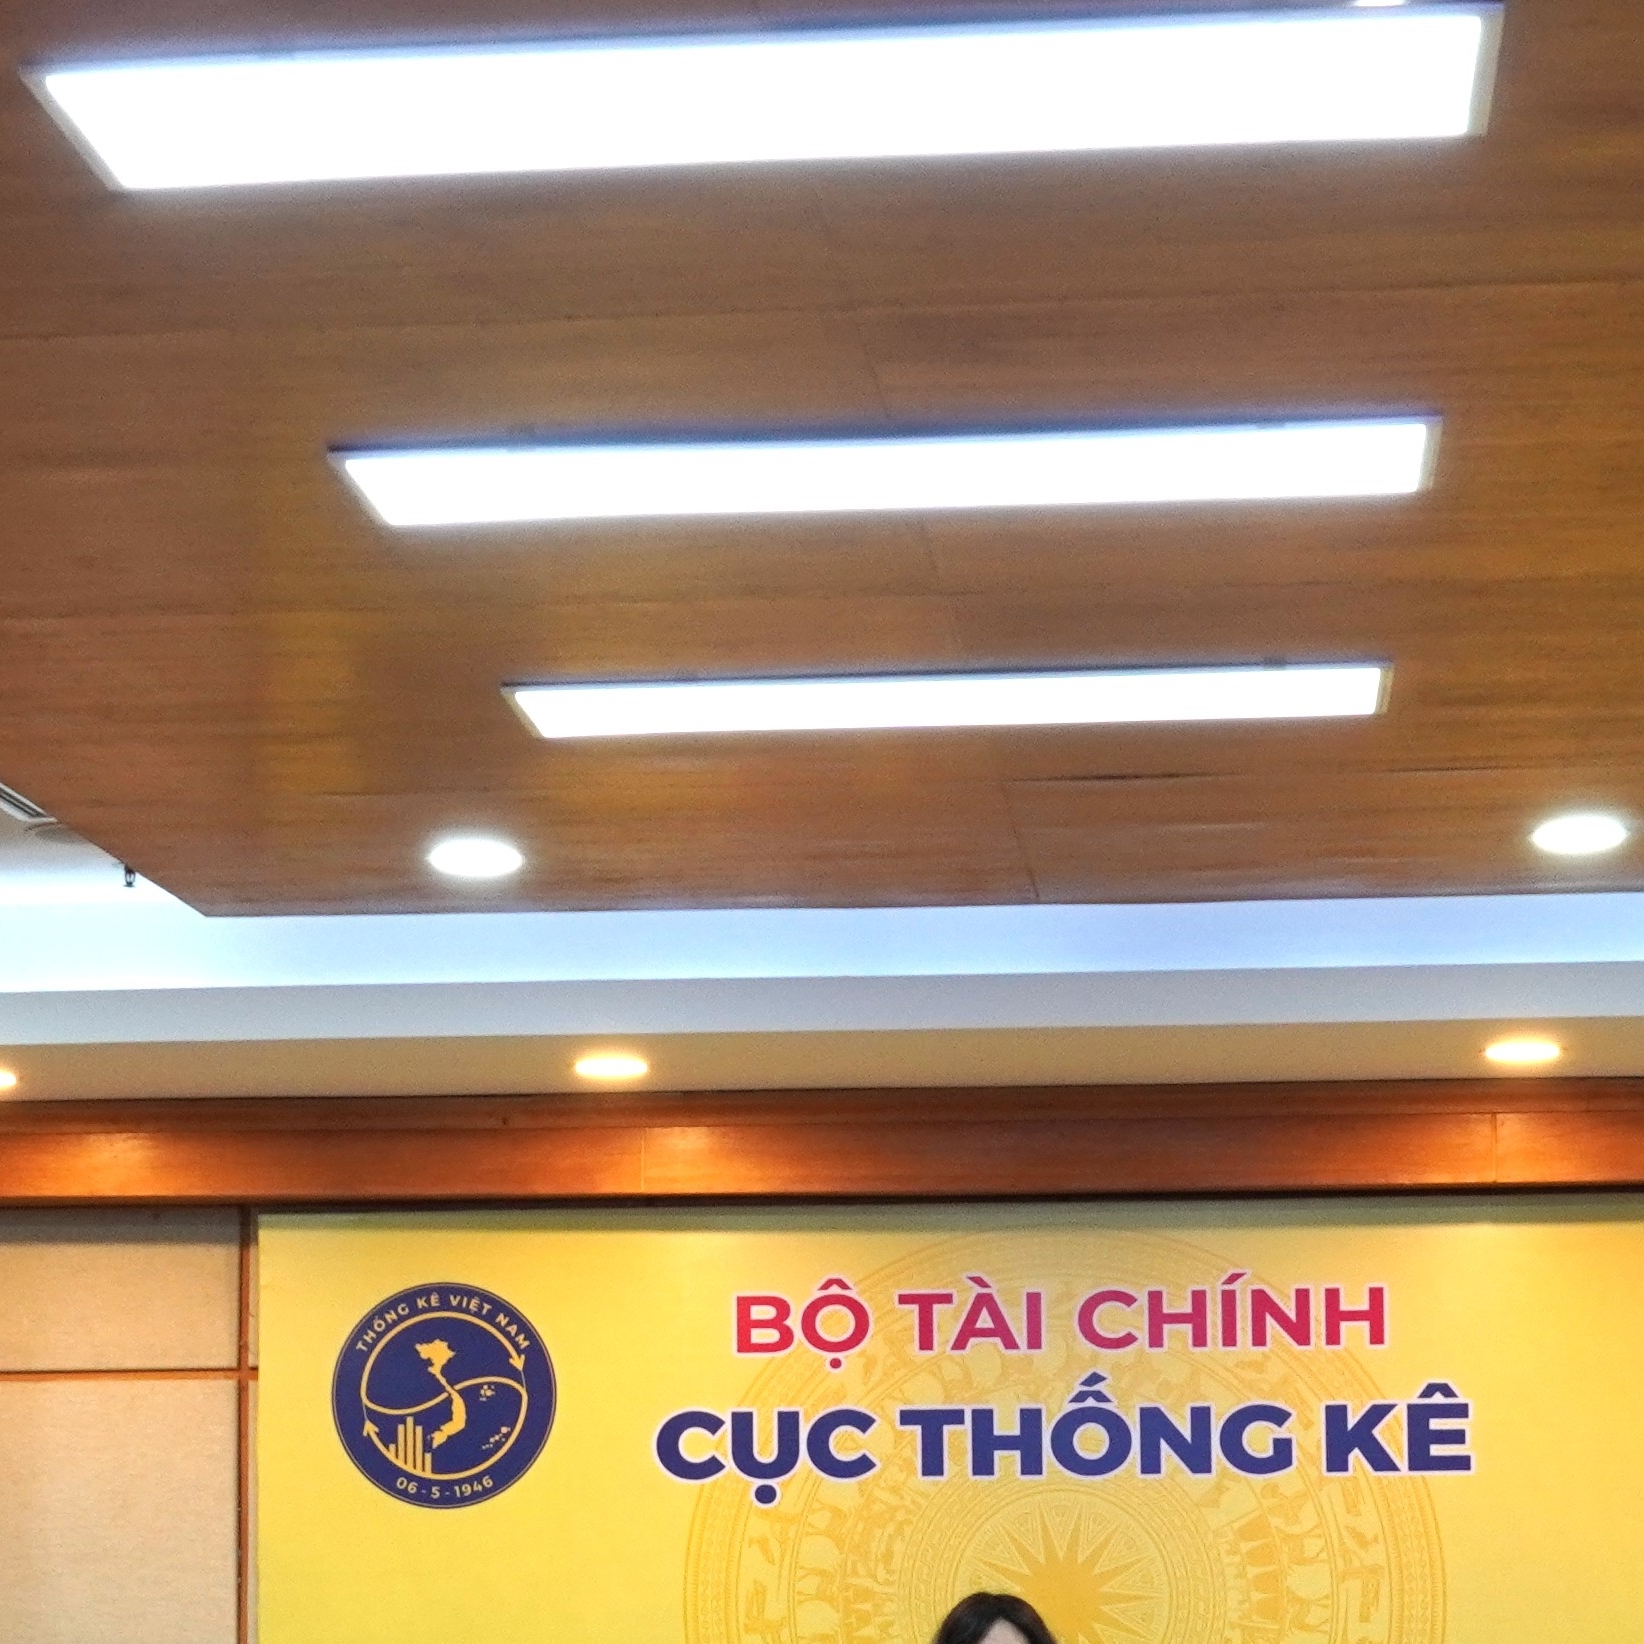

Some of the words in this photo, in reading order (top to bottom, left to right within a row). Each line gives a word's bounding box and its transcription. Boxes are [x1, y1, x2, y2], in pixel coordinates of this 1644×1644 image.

[355, 1303, 410, 1353] THỐNG
[416, 1291, 441, 1309] KÊ
[449, 1294, 493, 1315] VIỆT
[494, 1313, 531, 1350] NAM
[734, 1277, 871, 1370] BỘ
[897, 1275, 1044, 1351] TÀI
[1077, 1272, 1386, 1349] CHÍNH
[655, 1408, 878, 1505] CỤC
[899, 1371, 1294, 1477] THỐNG
[1324, 1382, 1472, 1473] KÊ
